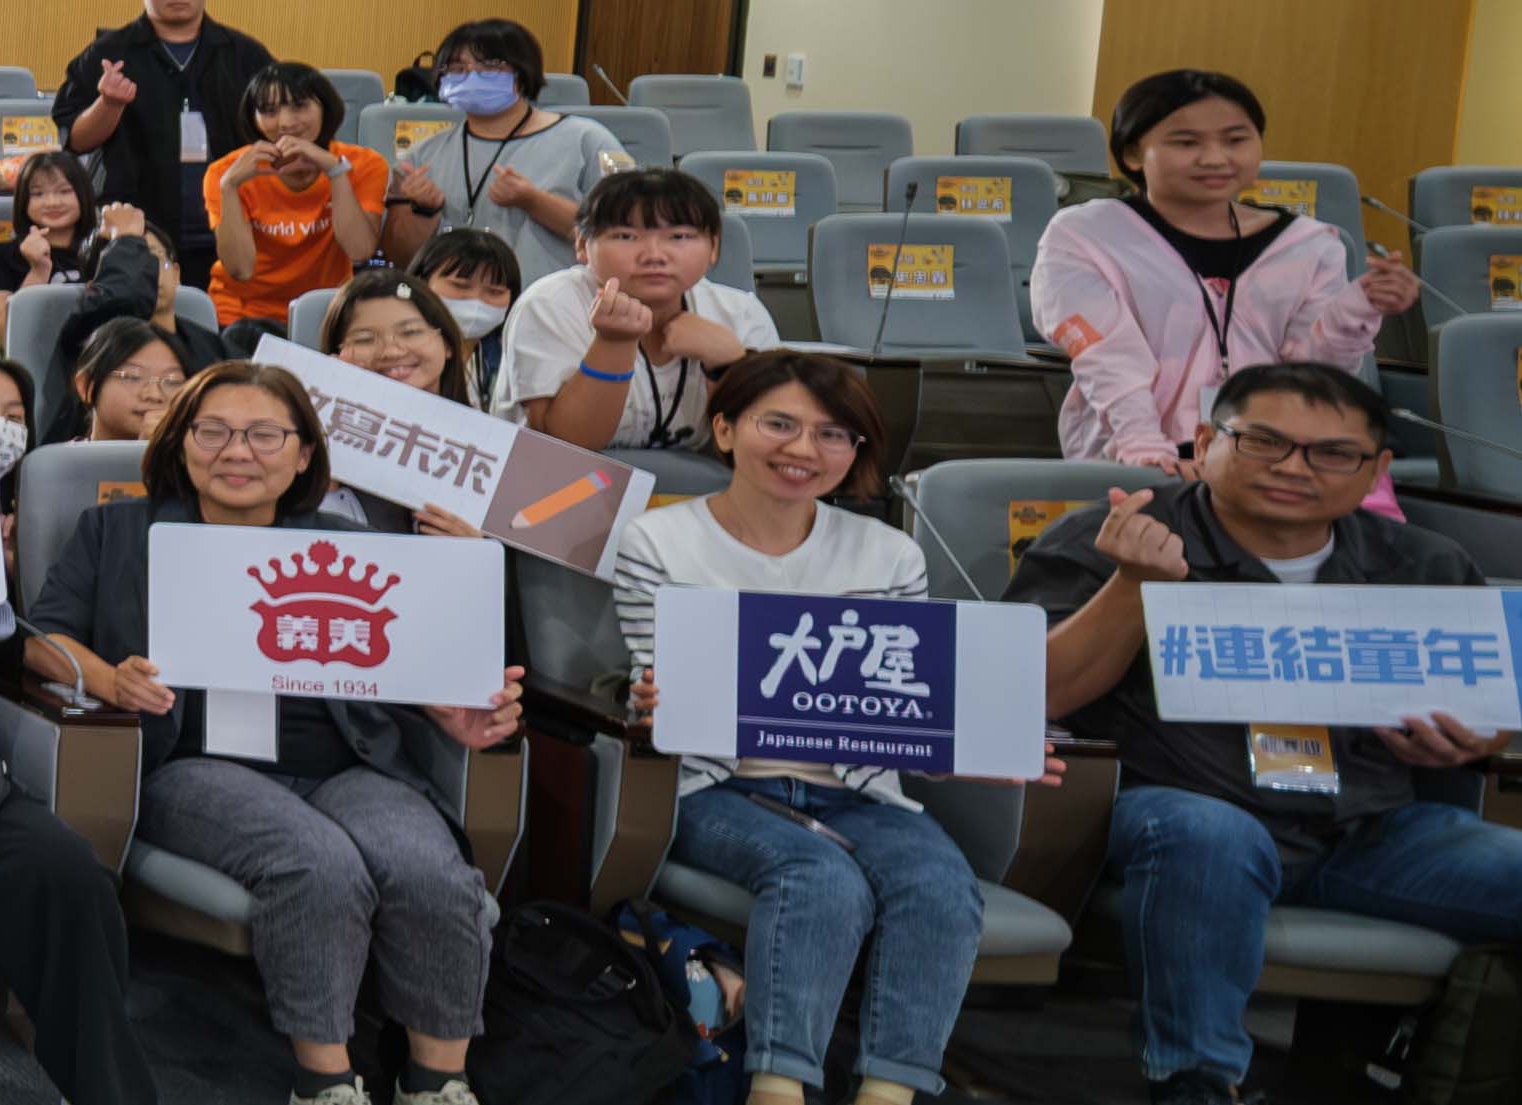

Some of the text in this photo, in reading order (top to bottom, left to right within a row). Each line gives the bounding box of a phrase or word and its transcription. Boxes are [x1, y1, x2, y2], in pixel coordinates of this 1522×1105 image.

[275, 614, 372, 656] 義美
[1159, 624, 1504, 686] #連結童年
[271, 673, 379, 697] Since 1934
[792, 691, 924, 720] OOTOYA
[757, 730, 933, 757] Japanese Restaurant
